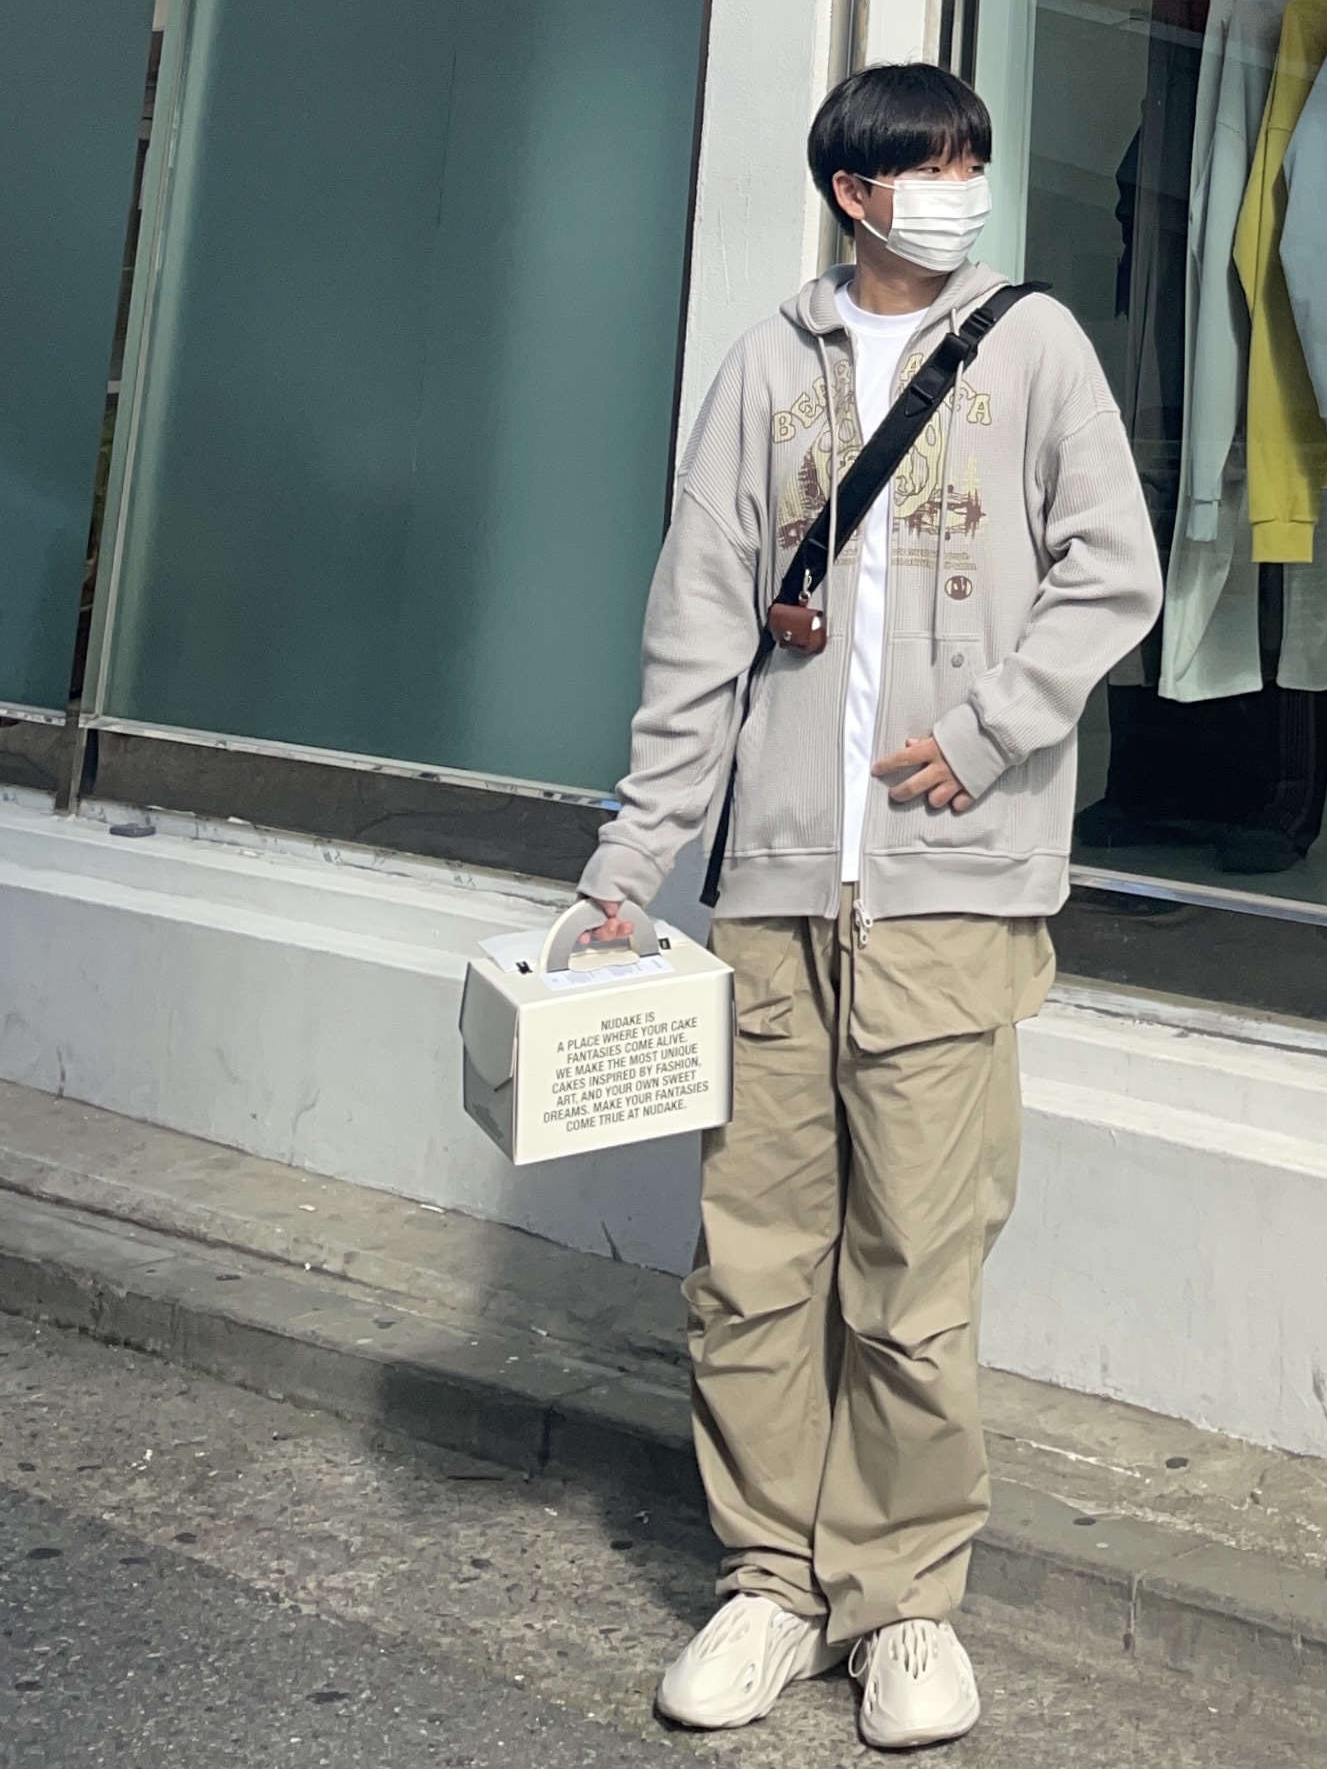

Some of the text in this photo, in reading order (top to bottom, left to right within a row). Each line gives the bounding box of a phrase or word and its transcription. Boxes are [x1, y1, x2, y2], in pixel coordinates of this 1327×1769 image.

[557, 1016, 697, 1053] A PLACE WHERE YOUR CAKE
[601, 1011, 655, 1030] NUDAKE IS
[556, 1043, 698, 1079] WE MAKE THE MOST UNIQUE
[567, 1032, 687, 1064] FANTASIES COME ALIVE.
[552, 1057, 702, 1094] CAKES INSPIRED BY FASHION,
[557, 1070, 696, 1107] ART, AND YOUR OWN SWEET
[543, 1081, 709, 1123] DREAMS. MAKE YOUR FANTASIES
[566, 1099, 686, 1132] COME TRUE AT NUDAKE.
